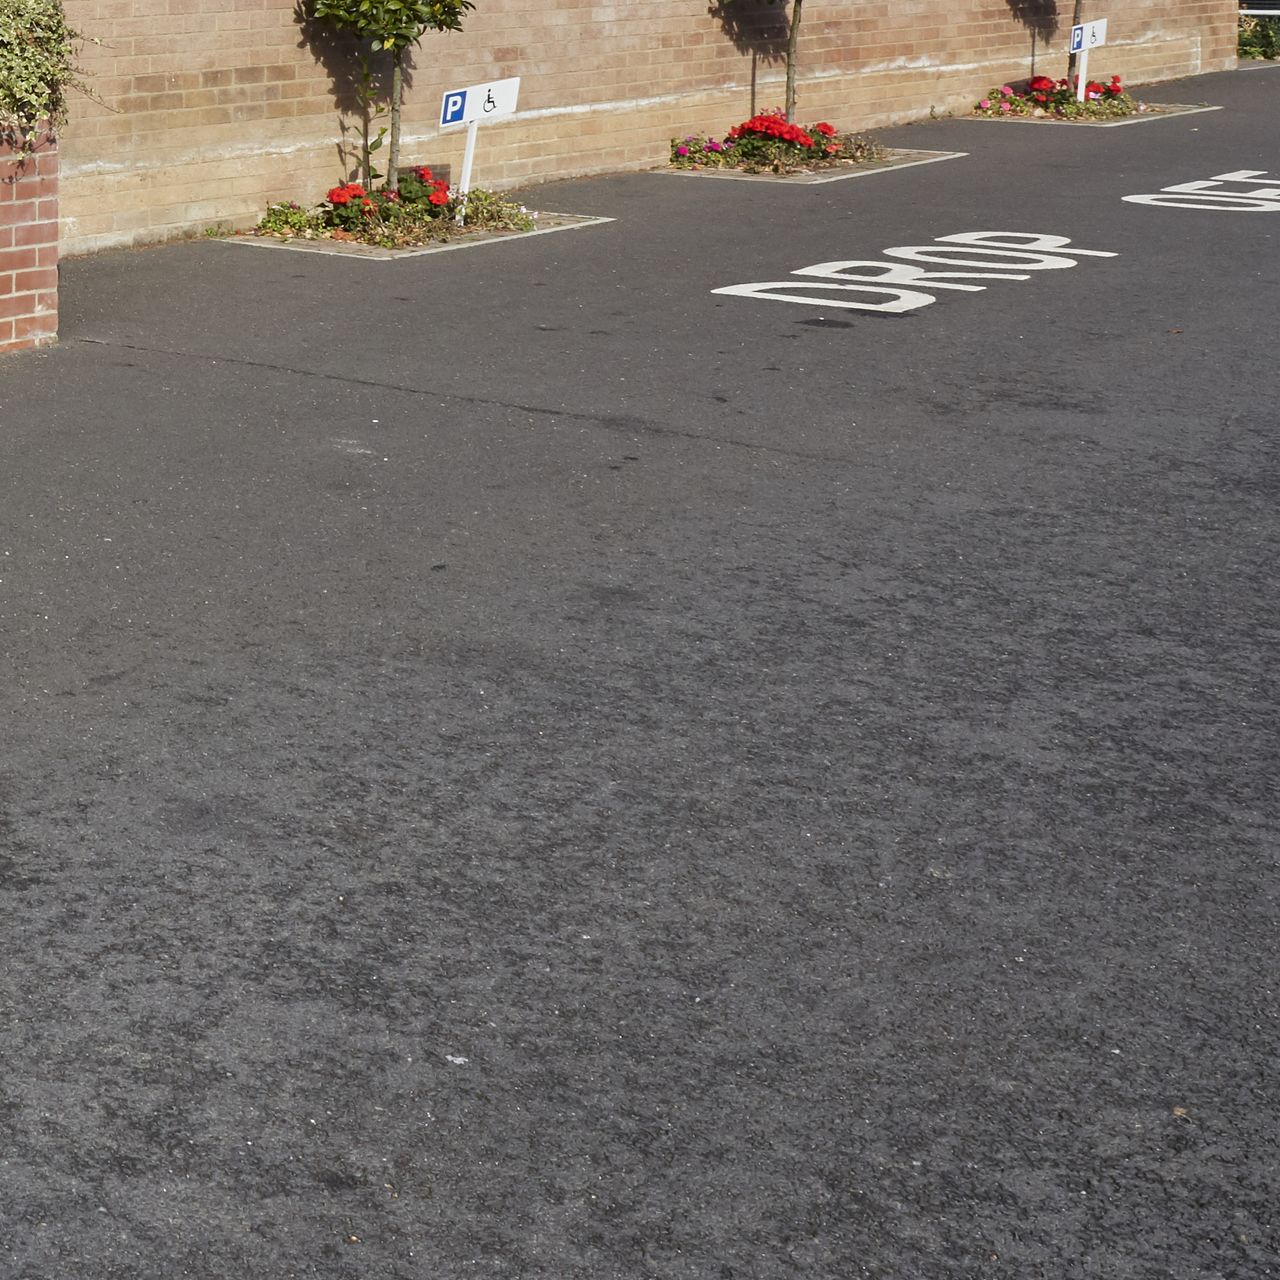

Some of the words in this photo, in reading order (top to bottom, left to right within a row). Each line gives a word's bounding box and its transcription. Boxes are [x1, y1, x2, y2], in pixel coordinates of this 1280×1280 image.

[1074, 29, 1081, 48] P
[446, 95, 462, 120] P
[710, 231, 1119, 313] DROP
